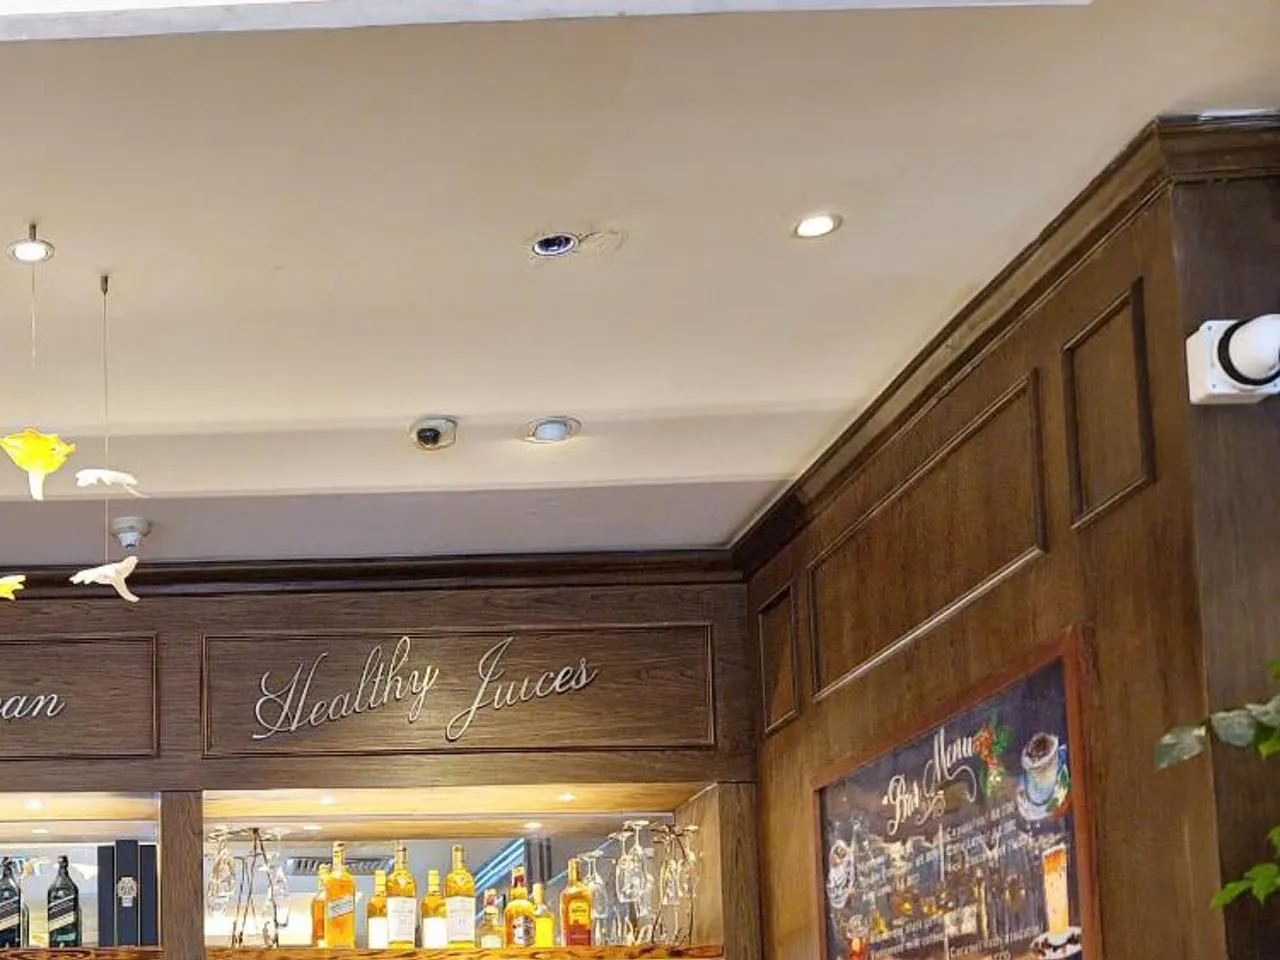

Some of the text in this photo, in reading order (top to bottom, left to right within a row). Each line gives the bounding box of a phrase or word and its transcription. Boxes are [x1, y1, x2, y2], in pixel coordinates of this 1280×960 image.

[252, 635, 599, 742] Healthy Juices
[922, 726, 977, 804] Menu
